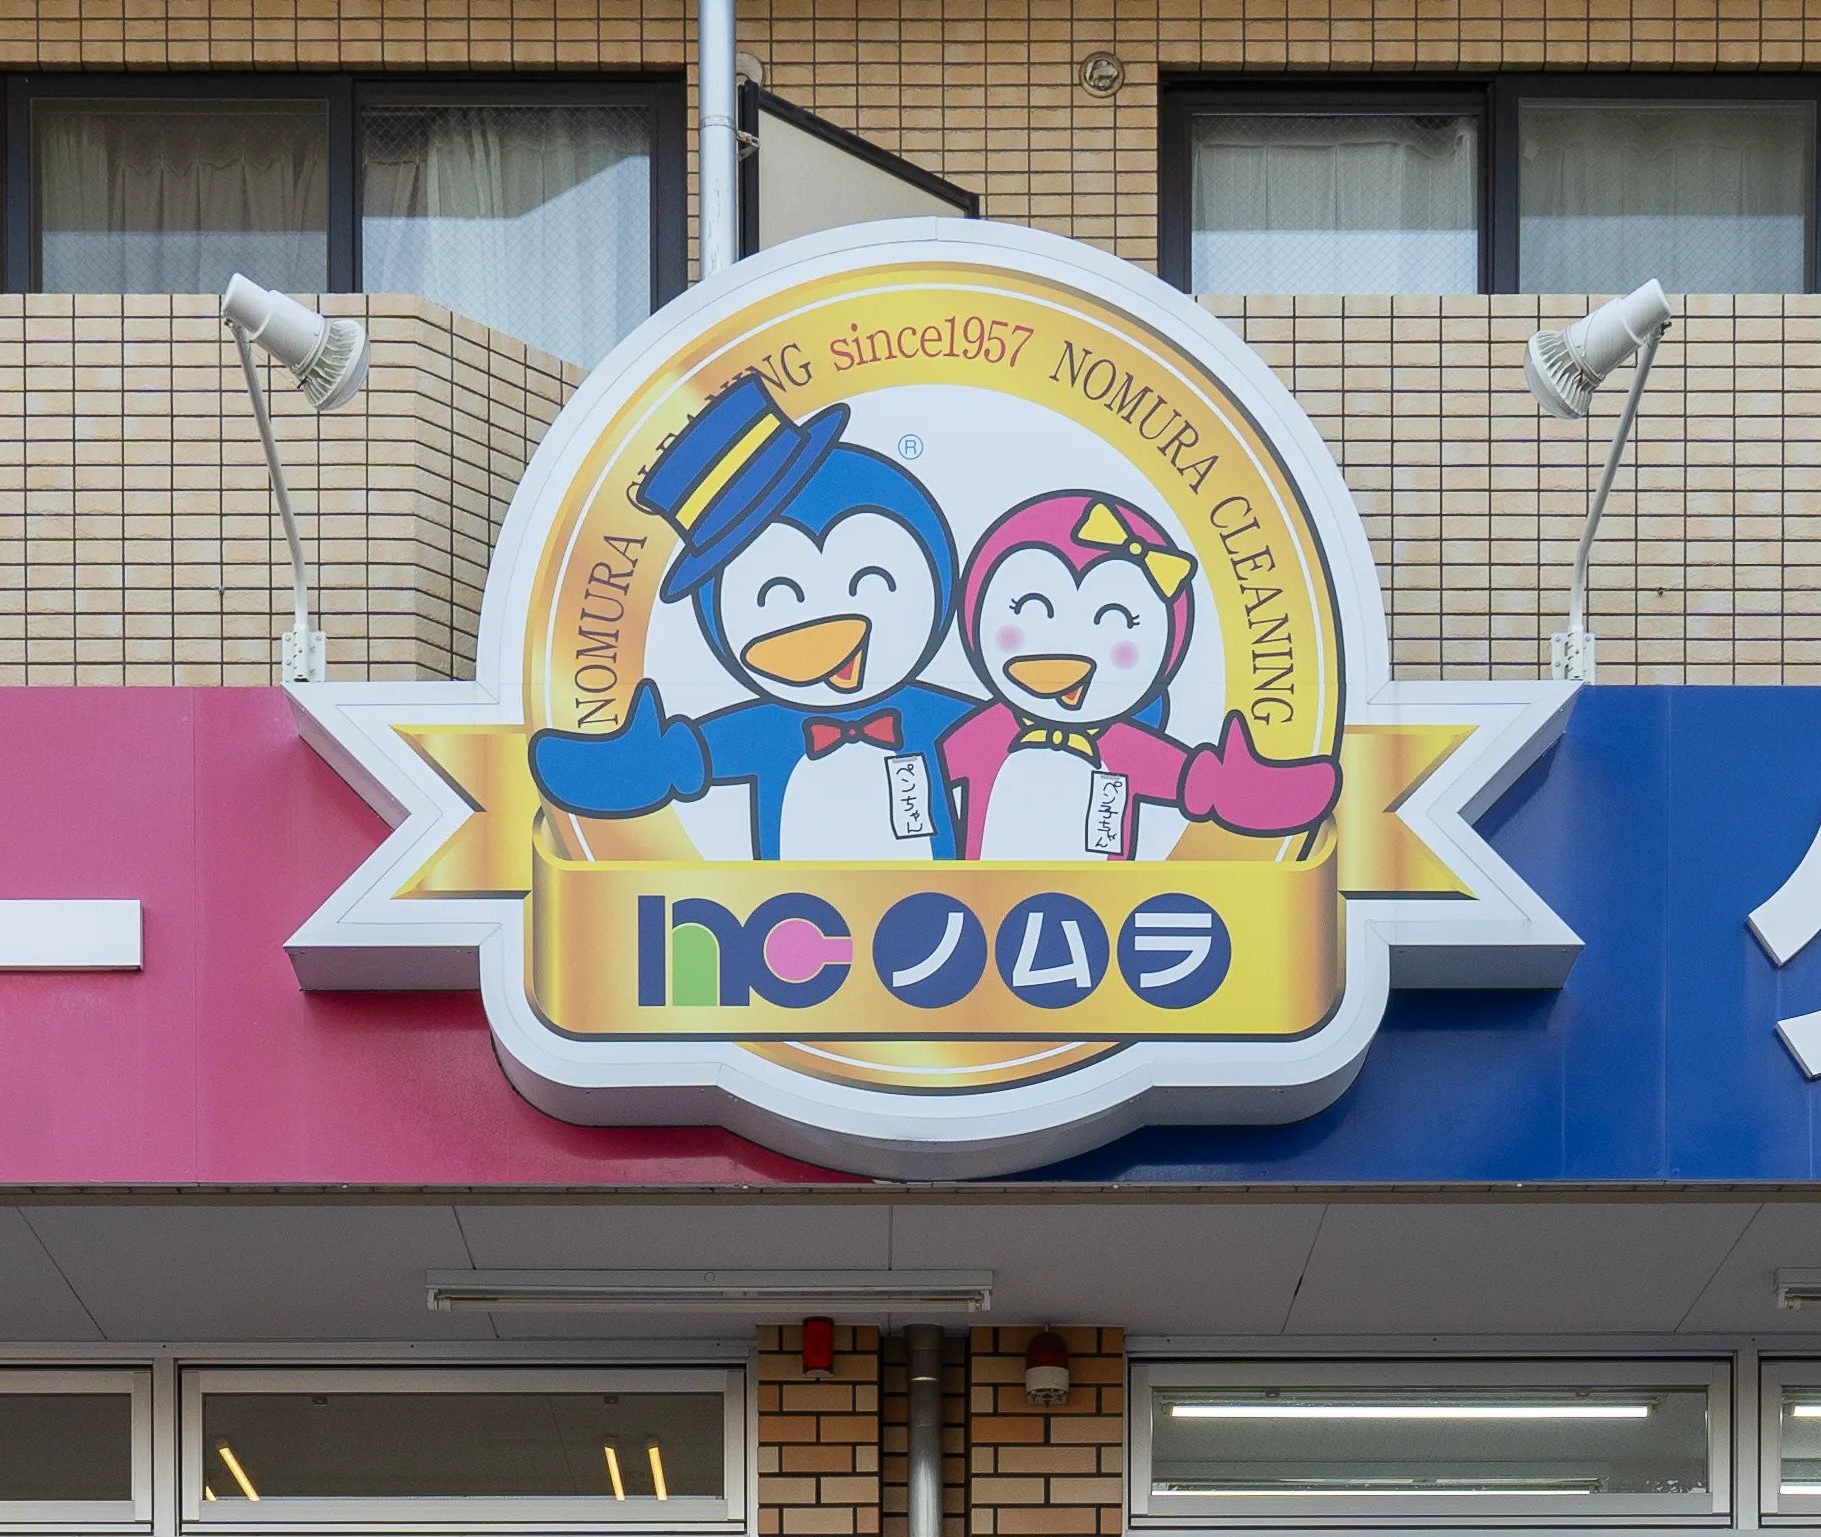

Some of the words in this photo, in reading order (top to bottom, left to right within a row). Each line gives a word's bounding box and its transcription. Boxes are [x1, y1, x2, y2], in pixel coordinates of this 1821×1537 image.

[830, 315, 1035, 373] since1957
[1049, 340, 1219, 494] NOMURA
[1209, 496, 1296, 726] CLEANING
[574, 533, 648, 728] NOMURA
[882, 900, 1223, 1002] ノムラ
